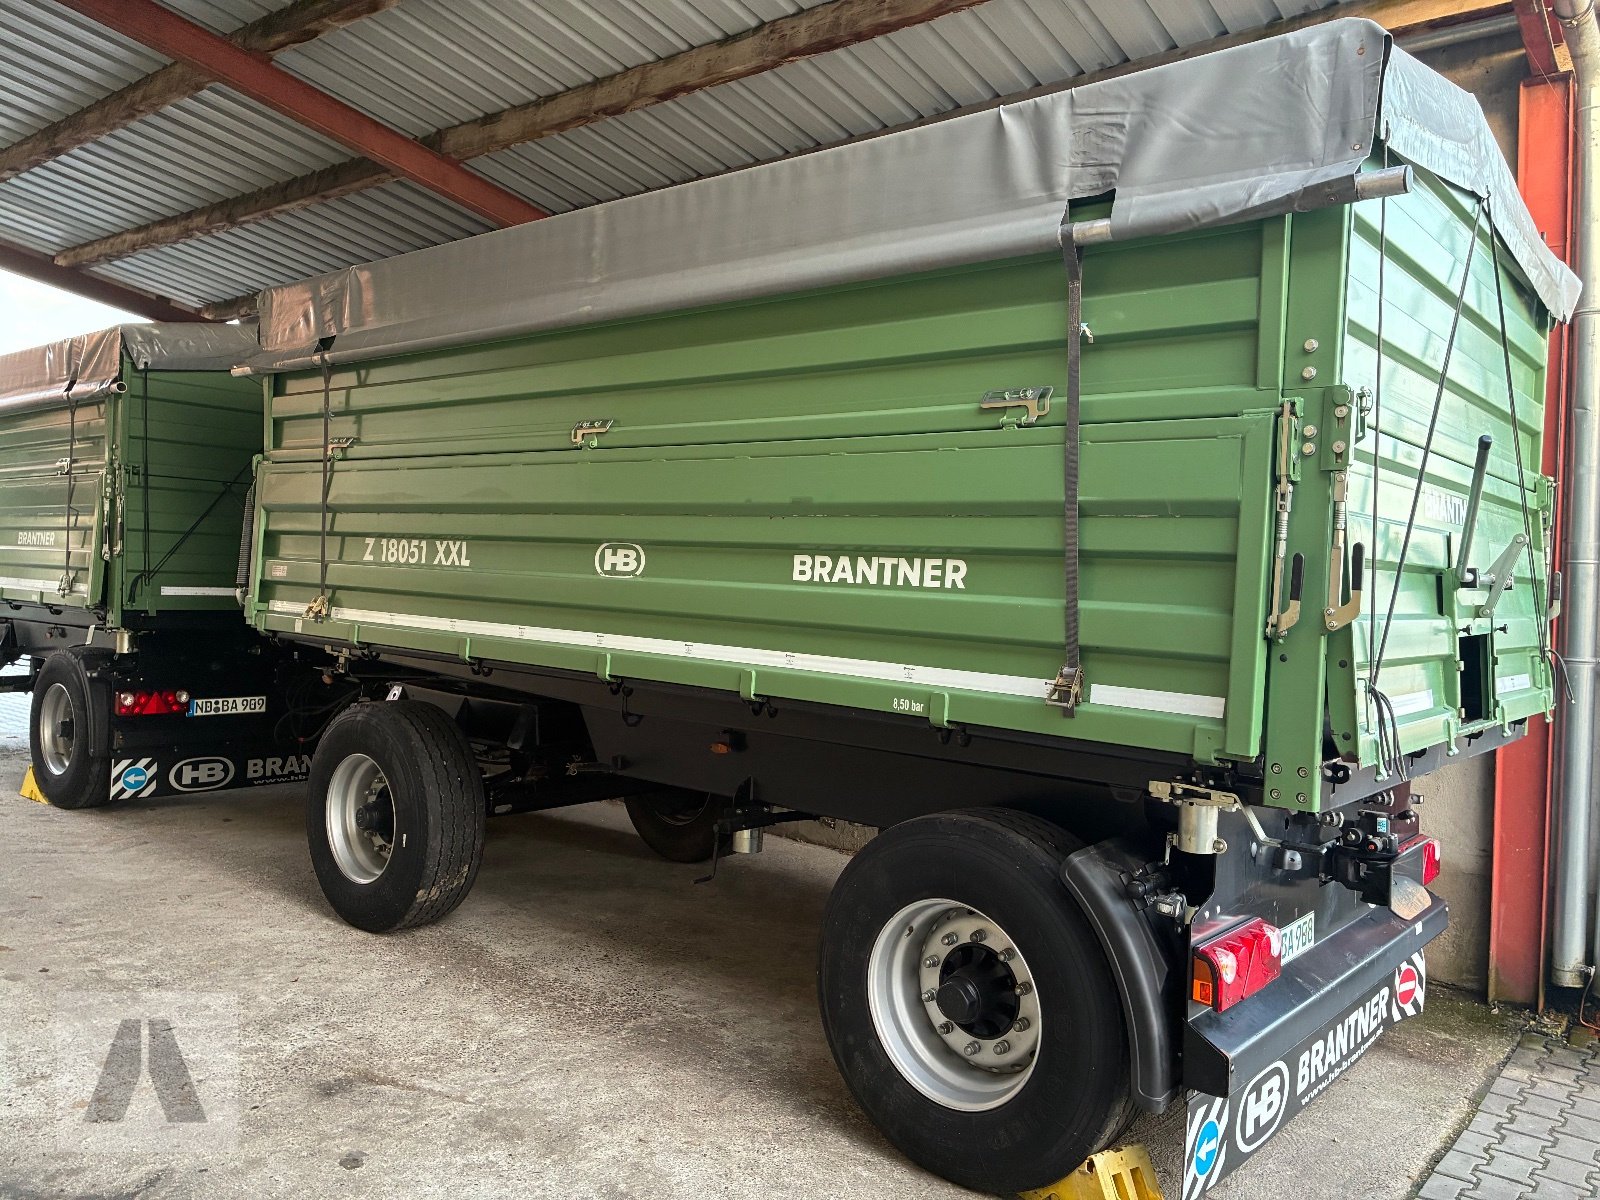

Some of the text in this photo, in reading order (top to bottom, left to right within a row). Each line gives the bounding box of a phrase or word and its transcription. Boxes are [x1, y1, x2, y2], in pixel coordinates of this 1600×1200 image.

[17, 531, 56, 546] BRANTNER
[362, 538, 470, 567] Z 18051 XXL
[792, 554, 968, 587] BRANTNER
[221, 699, 238, 713] BA
[892, 698, 924, 713] 8,50 bar
[1296, 986, 1390, 1097] BRANTNER
